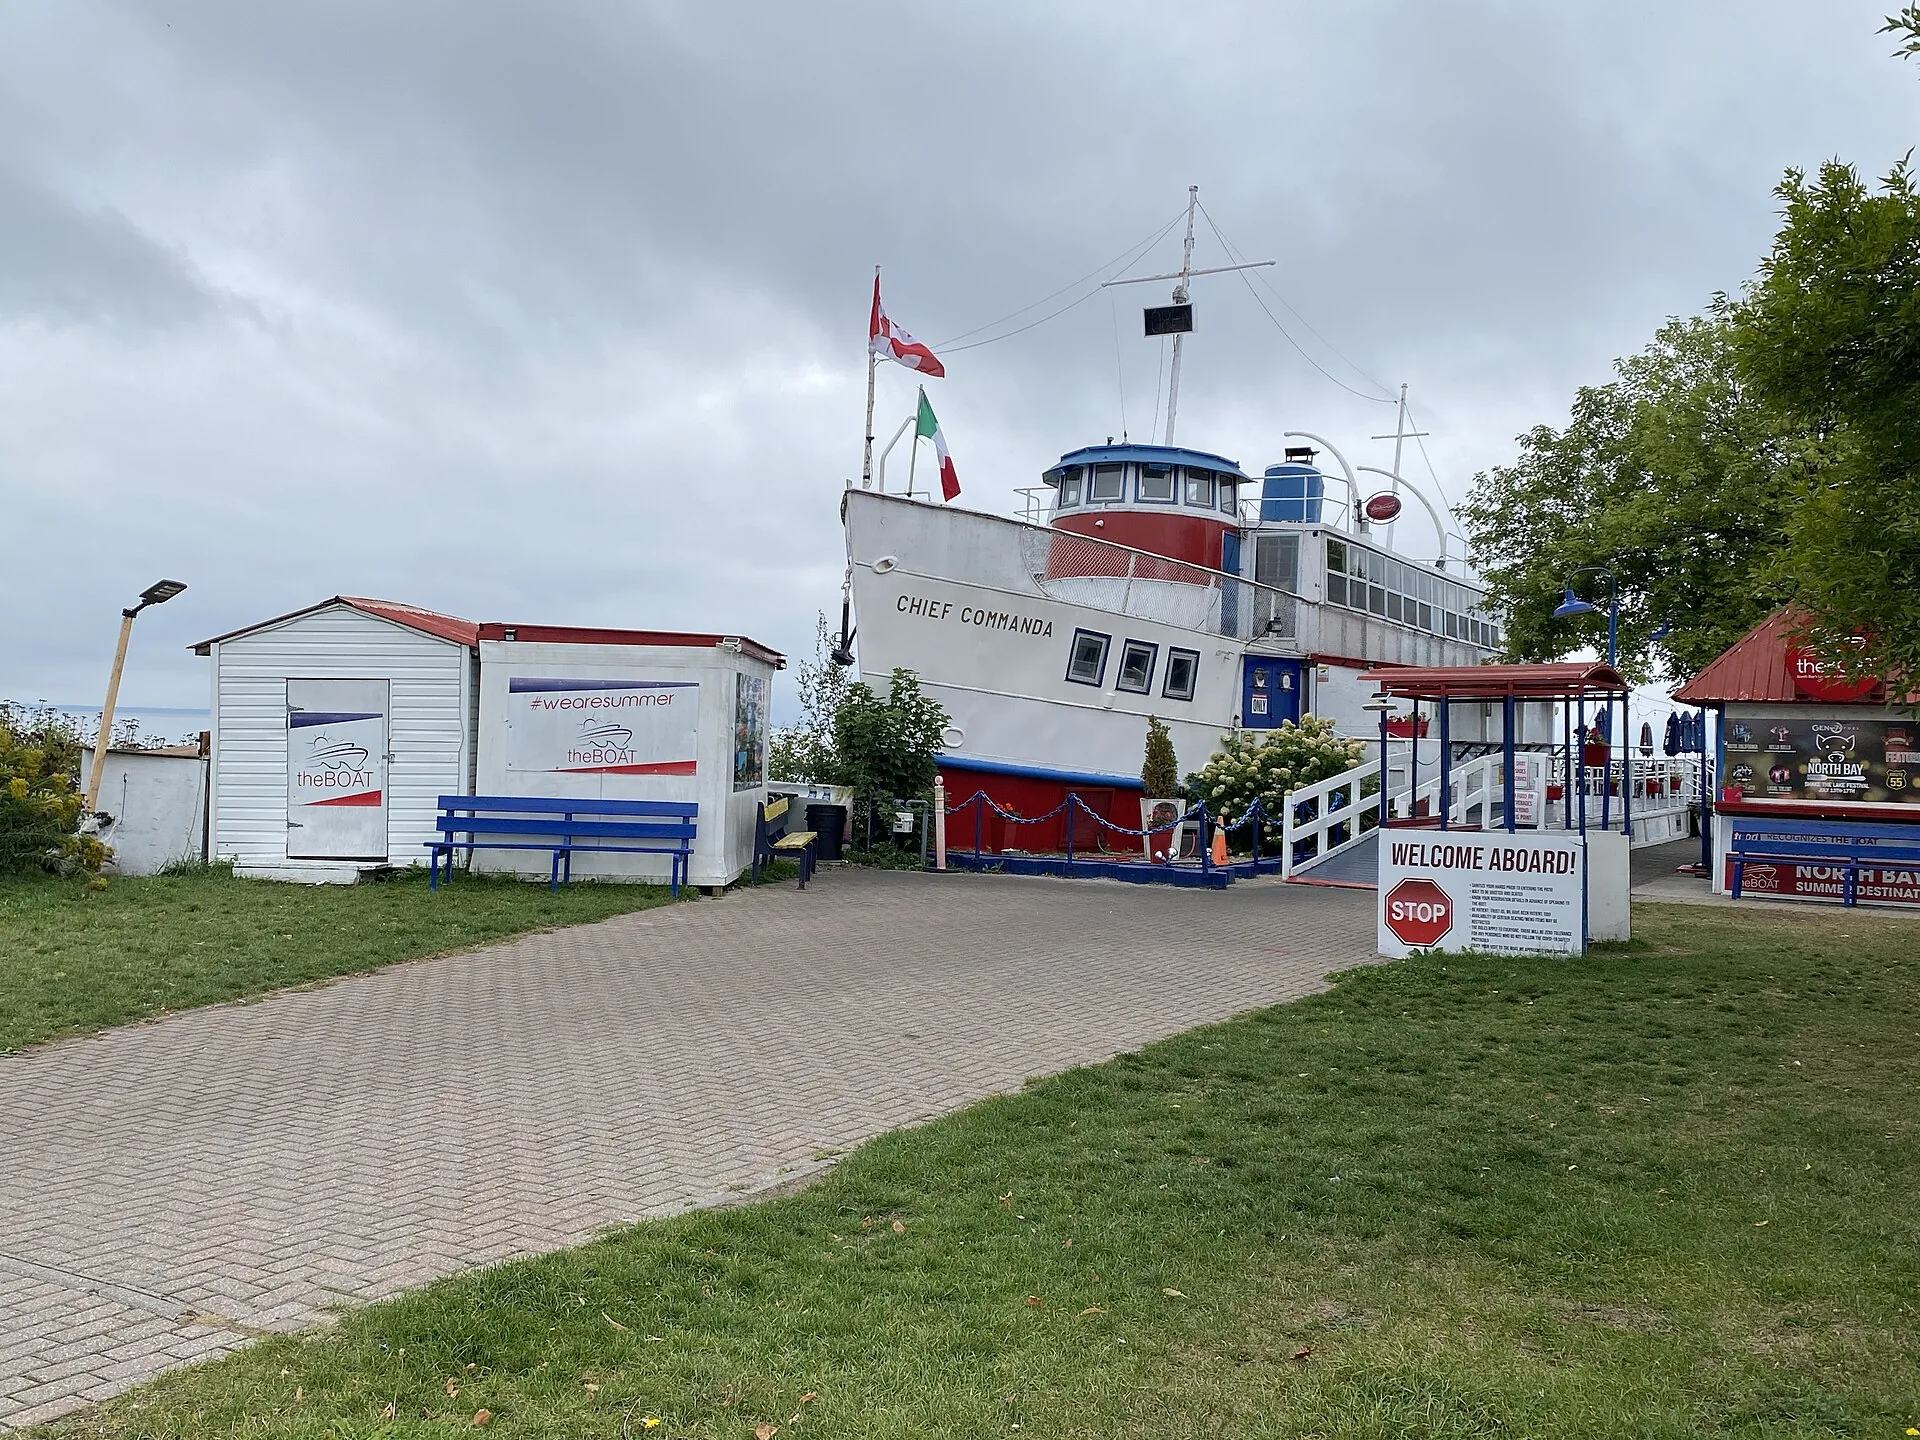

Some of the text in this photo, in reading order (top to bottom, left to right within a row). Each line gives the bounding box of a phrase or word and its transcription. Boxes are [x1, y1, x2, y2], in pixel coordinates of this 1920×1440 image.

[896, 595, 1053, 638] CHIEF COMMANDA
[530, 693, 675, 711] #wearesummer
[1252, 699, 1267, 712] ONLY
[568, 748, 638, 764] theBOAT
[1808, 763, 1864, 776] NORTH BAY
[297, 770, 374, 788] theBOAT
[1890, 777, 1903, 787] 55
[1768, 834, 1828, 843] RECOGNIZES
[1831, 836, 1850, 844] THE
[1392, 842, 1576, 875] WELCOME ABOARD!
[1796, 865, 1875, 883] NORH
[1856, 885, 1920, 899] DESTINAT
[1391, 900, 1446, 924] STOP
